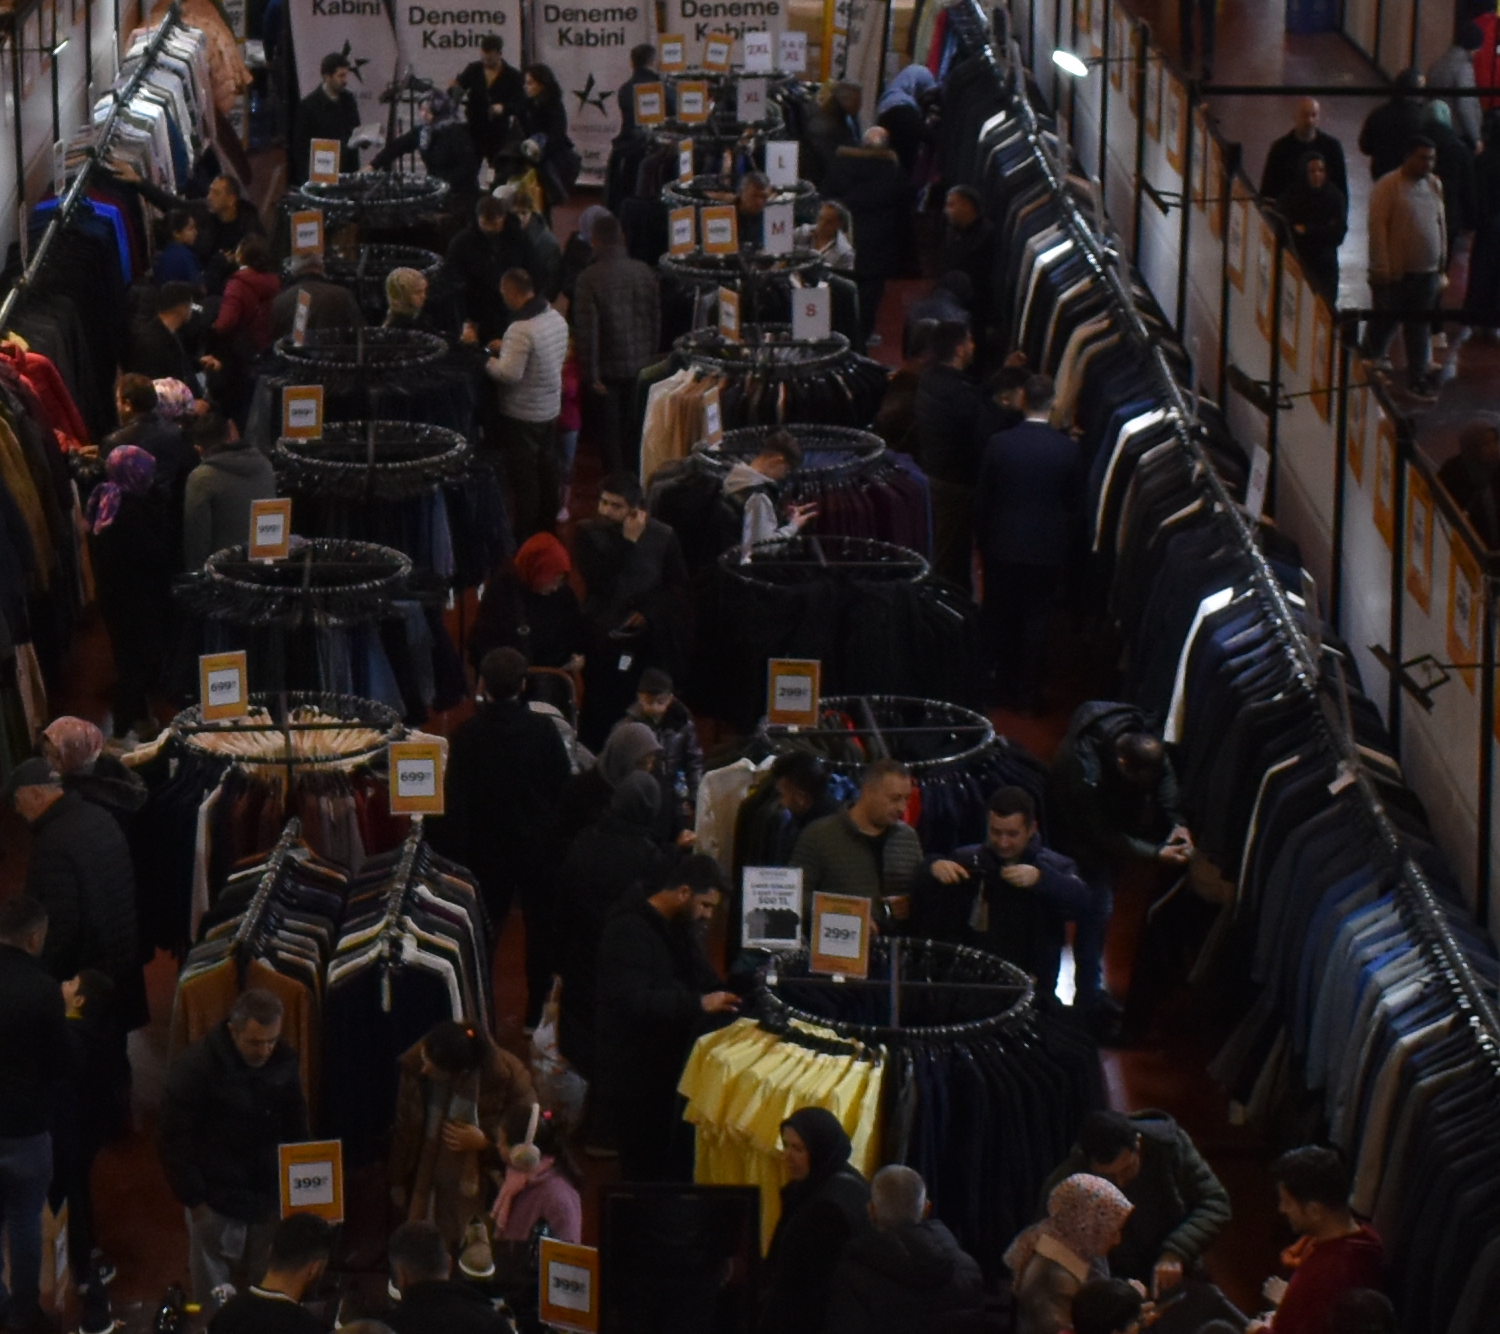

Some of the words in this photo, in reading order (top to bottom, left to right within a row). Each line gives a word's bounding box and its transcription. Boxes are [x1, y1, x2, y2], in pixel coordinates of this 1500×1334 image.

[409, 6, 506, 25] Deneme
[544, 5, 637, 23] Deneme
[681, 0, 779, 17] Deneme
[559, 28, 625, 47] Kabini
